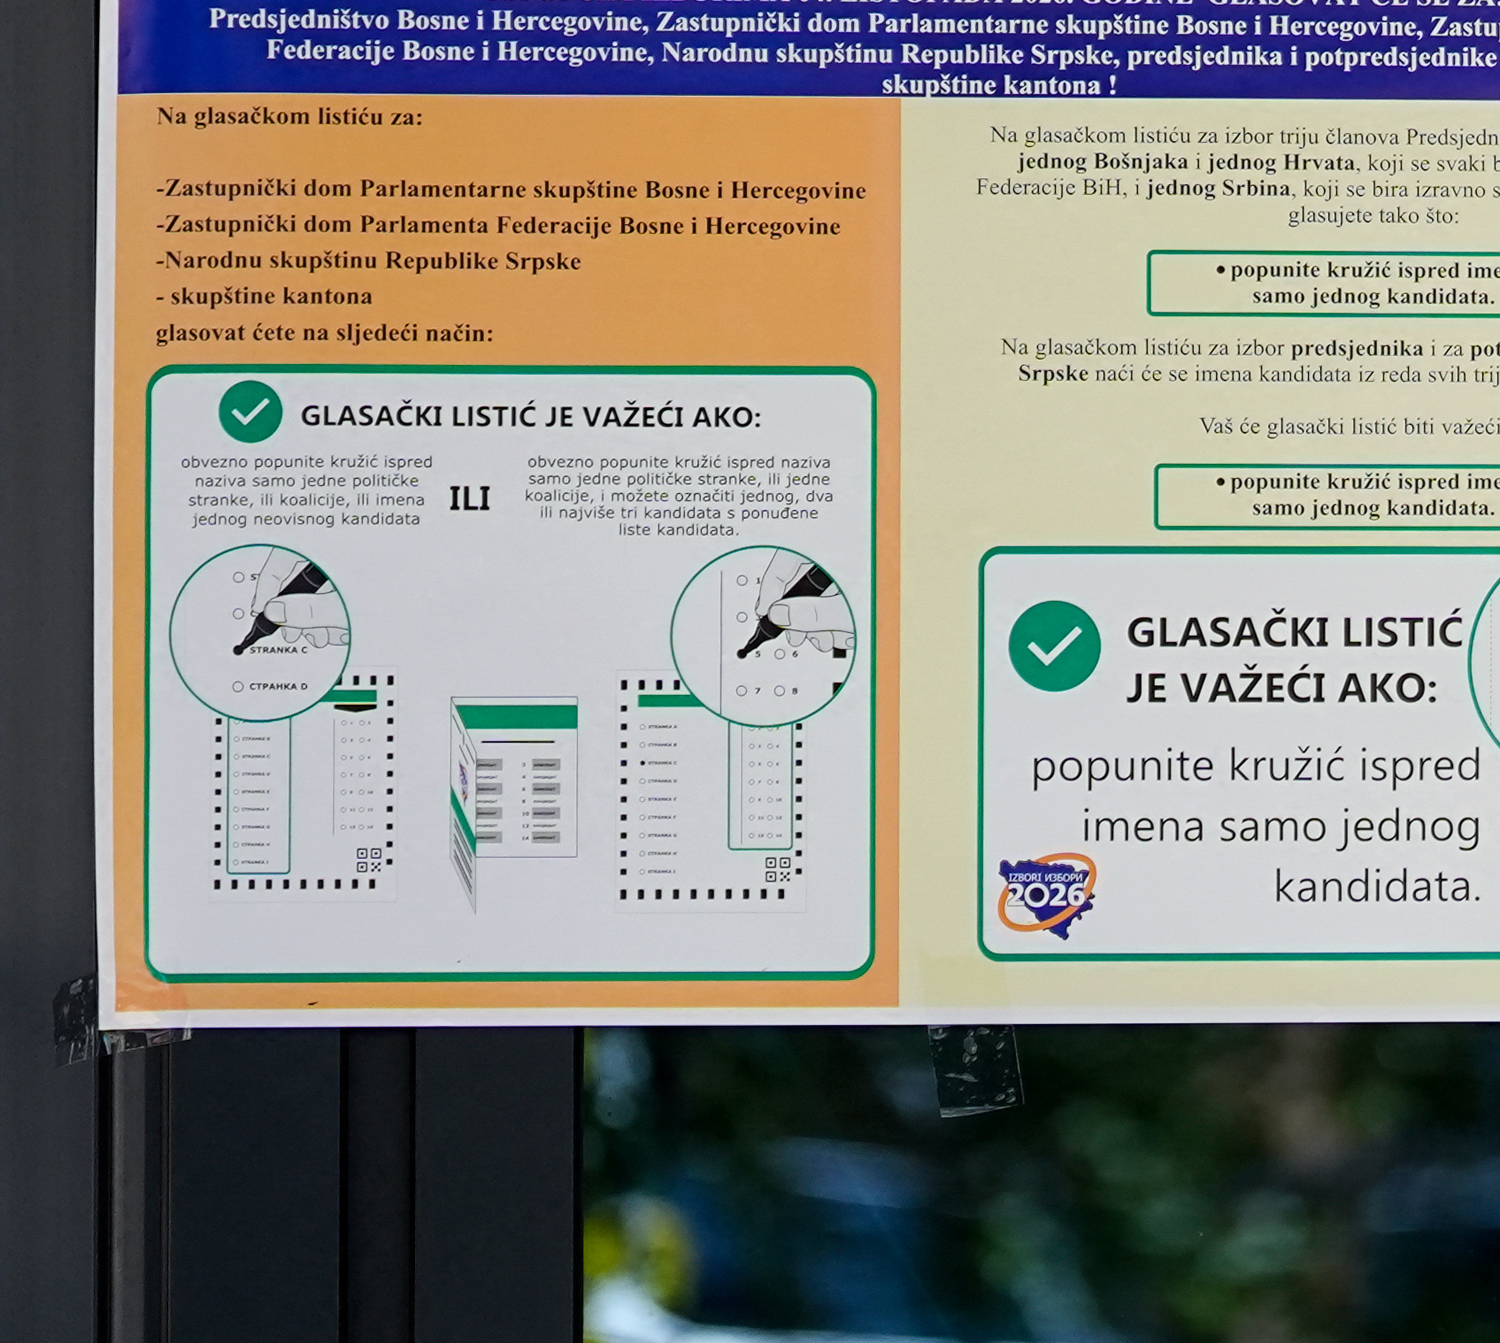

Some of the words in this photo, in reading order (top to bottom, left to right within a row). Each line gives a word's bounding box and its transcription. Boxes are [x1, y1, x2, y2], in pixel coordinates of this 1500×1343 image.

[157, 214, 295, 238] -Zastupnički
[304, 214, 351, 233] dom
[362, 215, 488, 234] Parlamenta
[498, 216, 611, 239] Federacije
[621, 216, 683, 234] Bosne
[692, 216, 696, 234] i
[707, 216, 840, 240] Hercegovine
[302, 399, 442, 427] GLASAČKI
[453, 399, 535, 427] LISTIĆ
[546, 406, 573, 428] JE
[583, 400, 683, 428] VAŽEĆI
[693, 406, 760, 428] AKO:
[450, 485, 490, 511] ILI
[1009, 873, 1041, 882] IZBORI
[1045, 873, 1083, 882] ИЗБОРИ
[1007, 883, 1086, 908] 2026
